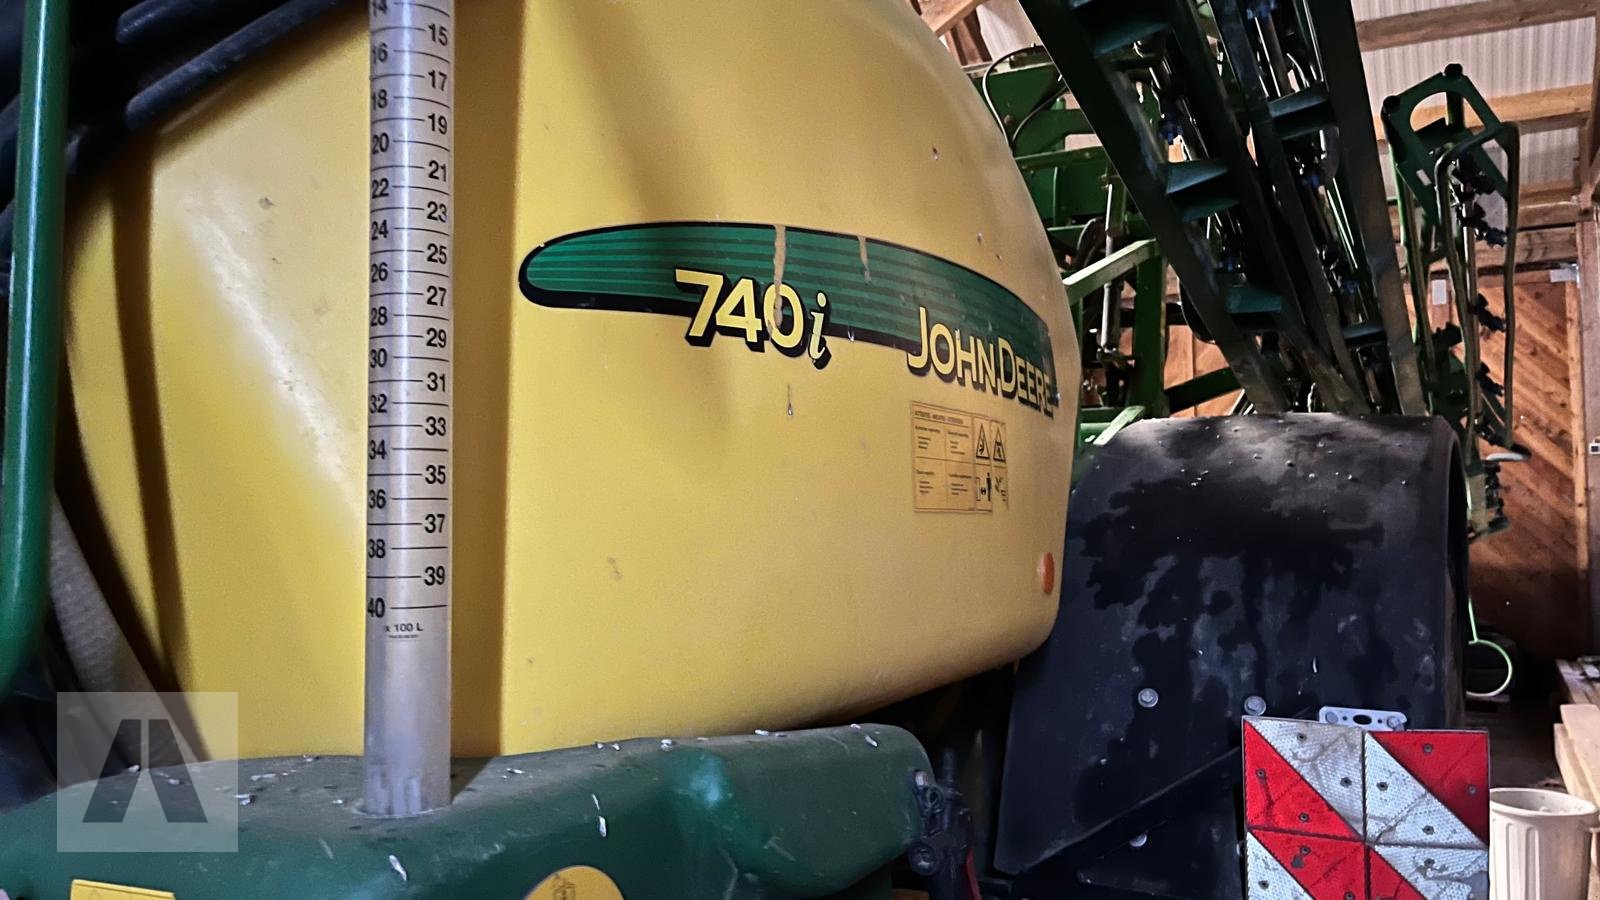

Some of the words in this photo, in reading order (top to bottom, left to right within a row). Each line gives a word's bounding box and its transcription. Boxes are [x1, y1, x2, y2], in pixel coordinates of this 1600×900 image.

[372, 0, 388, 16] 14
[428, 23, 448, 46] 15
[372, 42, 388, 64] 16
[428, 69, 447, 91] 17
[372, 89, 388, 110] 18
[428, 113, 447, 135] 19
[372, 132, 389, 154] 20
[428, 160, 446, 182] 21
[372, 178, 389, 199] 22
[427, 201, 447, 223] 23
[371, 219, 388, 240] 24
[427, 243, 447, 264] 25
[371, 262, 388, 283] 26
[427, 285, 447, 306] 27
[370, 306, 388, 327] 28
[674, 267, 829, 366] 740i
[426, 328, 447, 348] 29
[370, 348, 387, 368] 30
[907, 306, 998, 393] JOHN
[998, 337, 1055, 416] DEERE
[427, 372, 445, 392] 31
[370, 394, 387, 414] 32
[425, 416, 446, 436] 33
[368, 439, 386, 460] 34
[425, 465, 446, 484] 35
[368, 489, 386, 509] 36
[424, 514, 445, 533] 37
[368, 538, 386, 559] 38
[424, 566, 445, 586] 39
[367, 597, 385, 618] 40
[394, 623, 413, 632] 100
[416, 622, 423, 631] L
